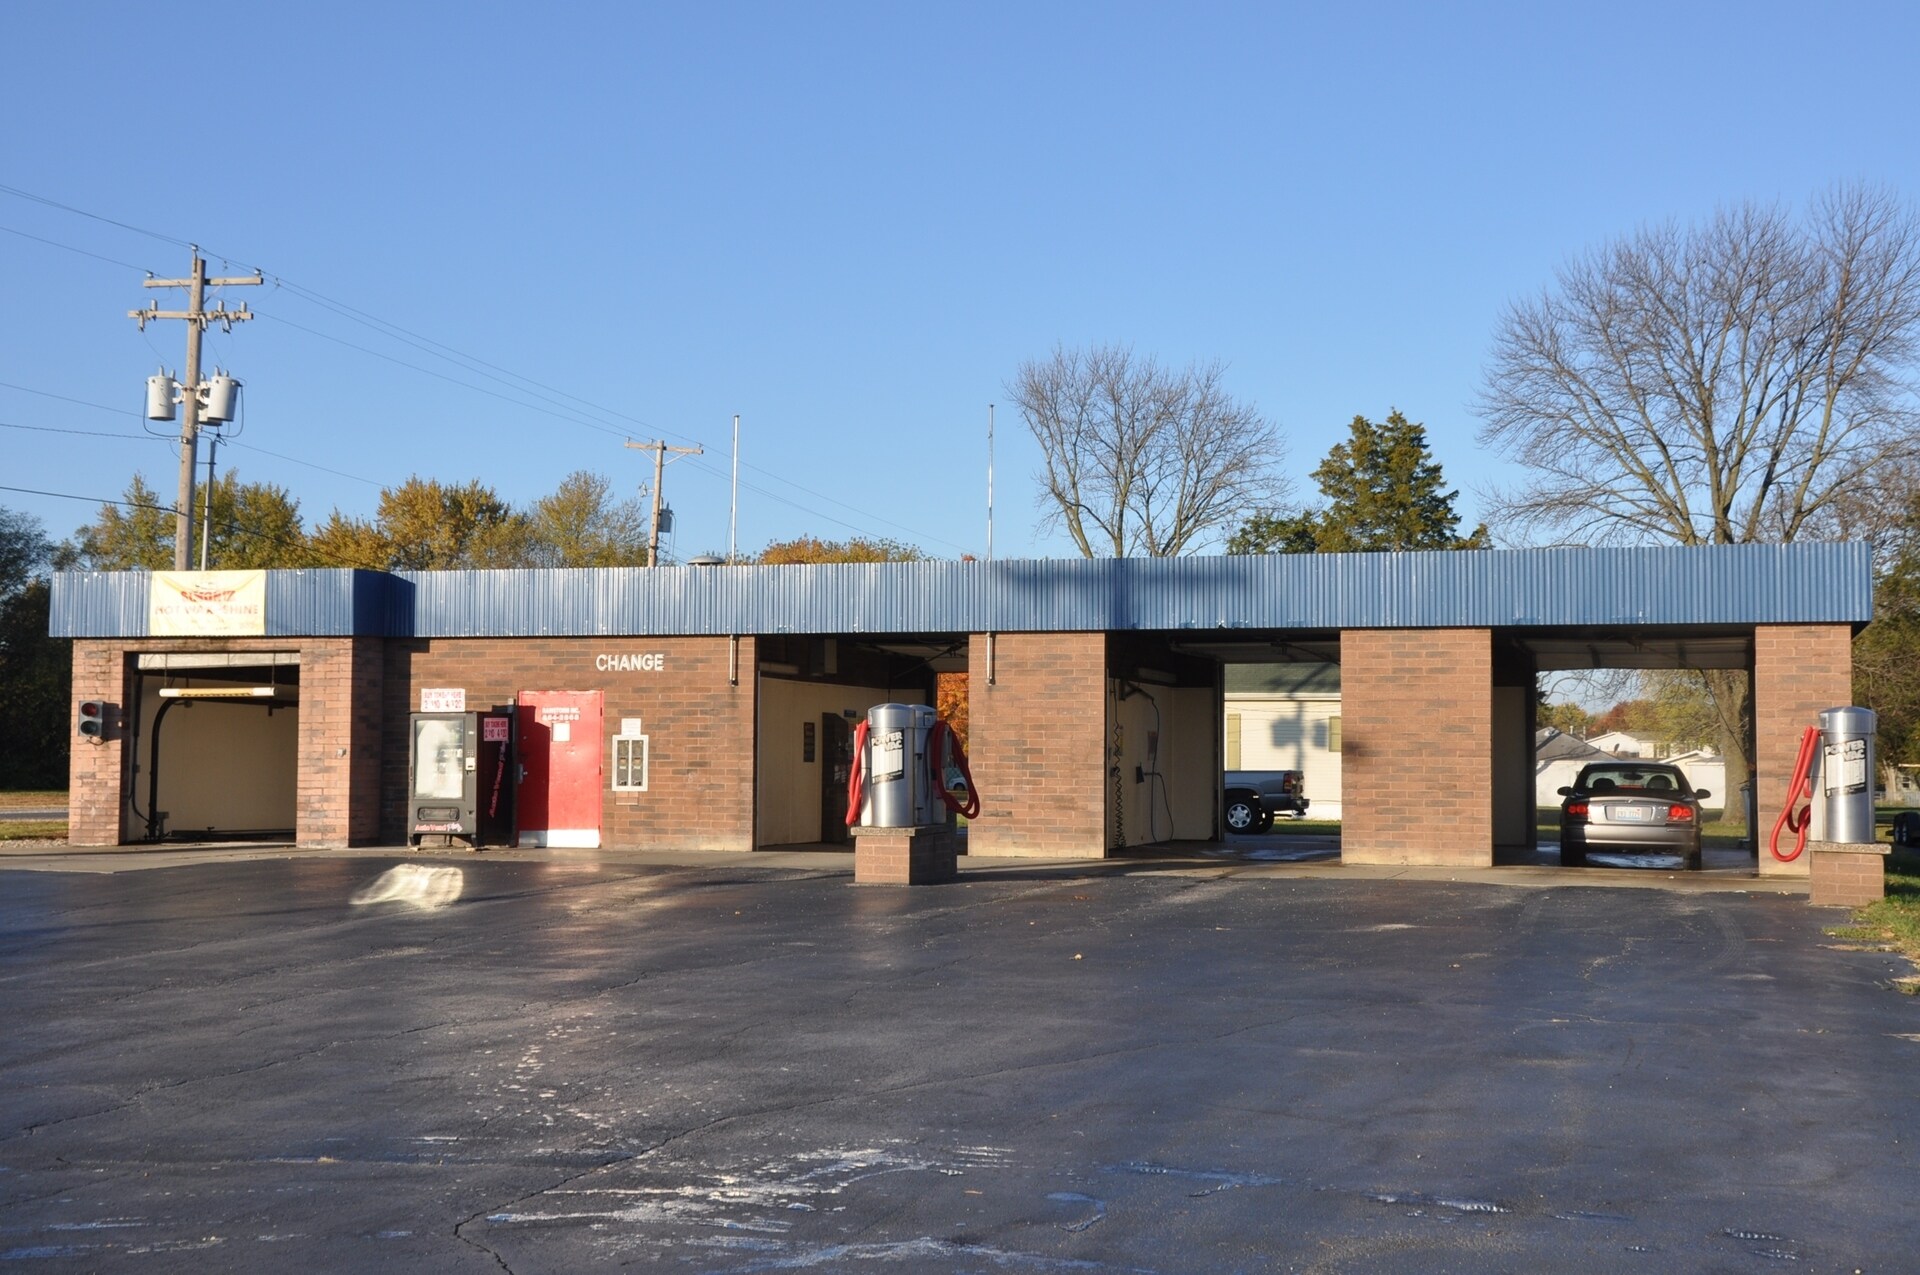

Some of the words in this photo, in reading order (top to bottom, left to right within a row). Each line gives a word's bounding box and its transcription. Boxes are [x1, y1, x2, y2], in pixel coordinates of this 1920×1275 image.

[222, 604, 259, 615] SHINE
[596, 654, 664, 671] CHANGE
[871, 731, 903, 747] POWER
[885, 740, 903, 751] VAC
[1824, 740, 1865, 756] POWER
[1843, 749, 1865, 760] VAC
